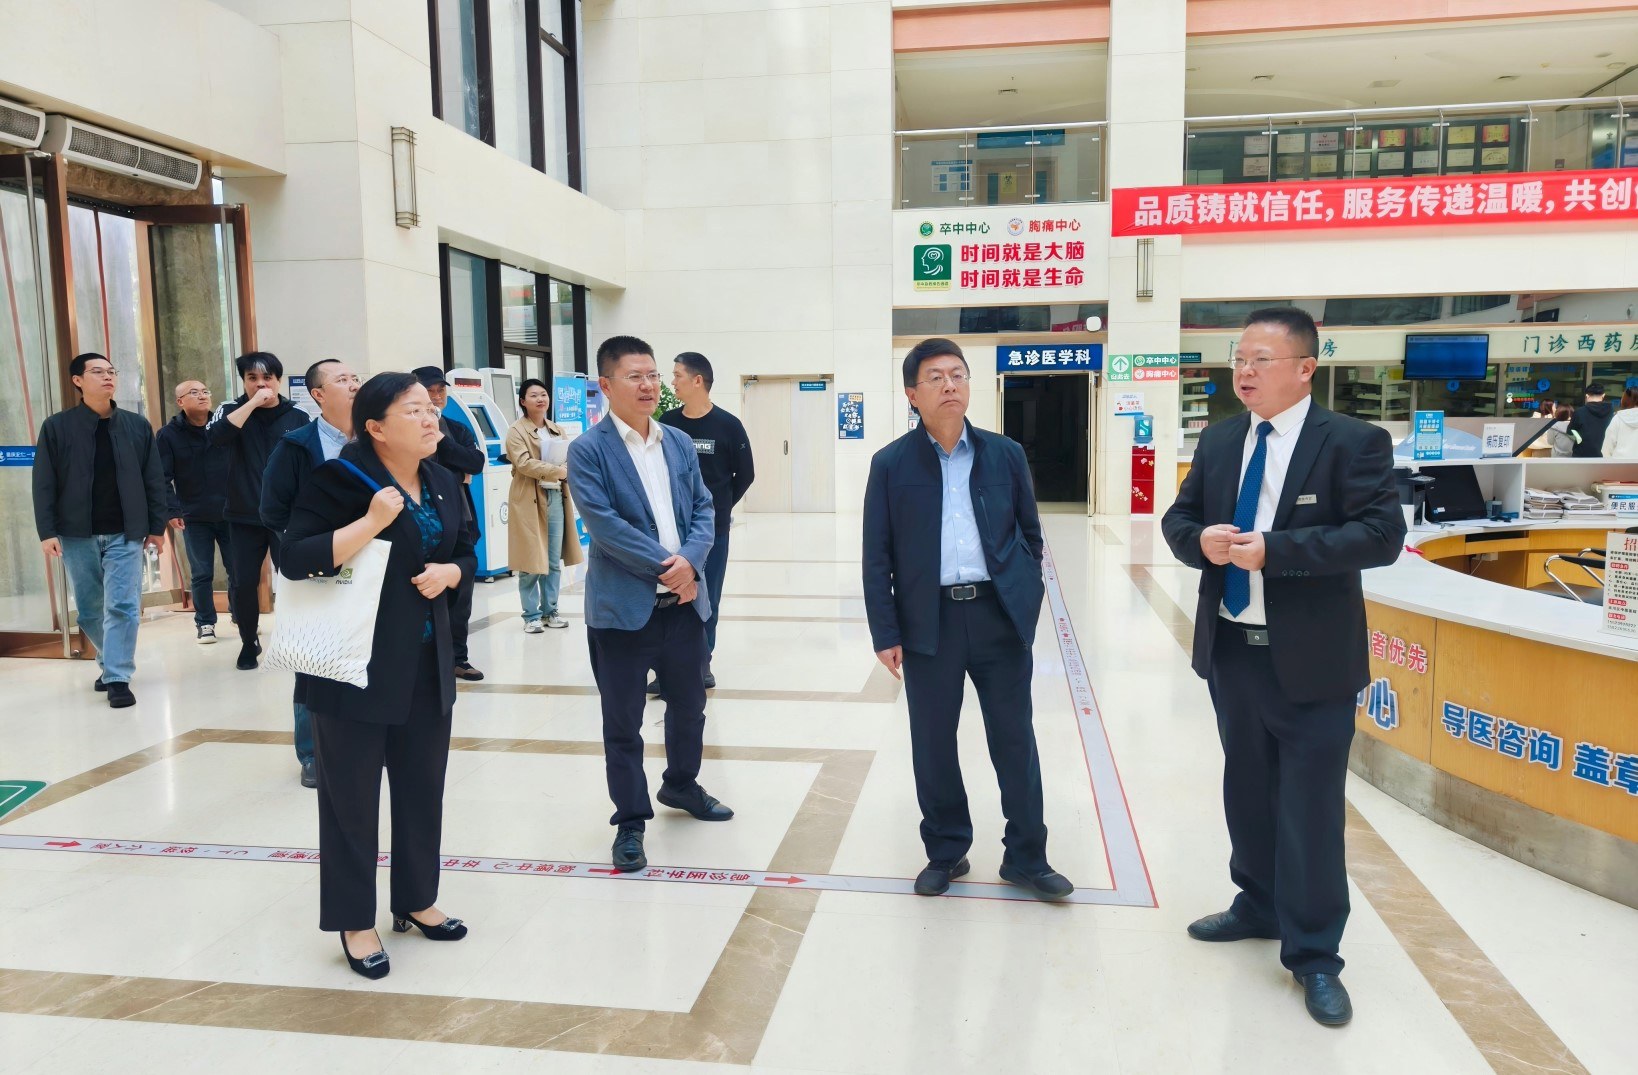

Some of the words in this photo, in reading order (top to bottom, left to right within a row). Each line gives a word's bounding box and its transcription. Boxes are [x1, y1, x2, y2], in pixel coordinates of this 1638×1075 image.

[940, 222, 990, 235] 卒中中心
[1028, 218, 1081, 233] 胸痛中心
[960, 241, 1085, 263] 时间就是大脑
[960, 266, 1085, 289] 时间就是生命
[1008, 349, 1091, 366] 急诊医学科
[1146, 356, 1177, 365] 卒中中心
[1146, 369, 1176, 378] 胸痛中心
[1611, 501, 1638, 511] 便民服
[1367, 629, 1429, 674] 者优先
[1357, 677, 1400, 731] 心
[1441, 701, 1563, 771] 导医咨询
